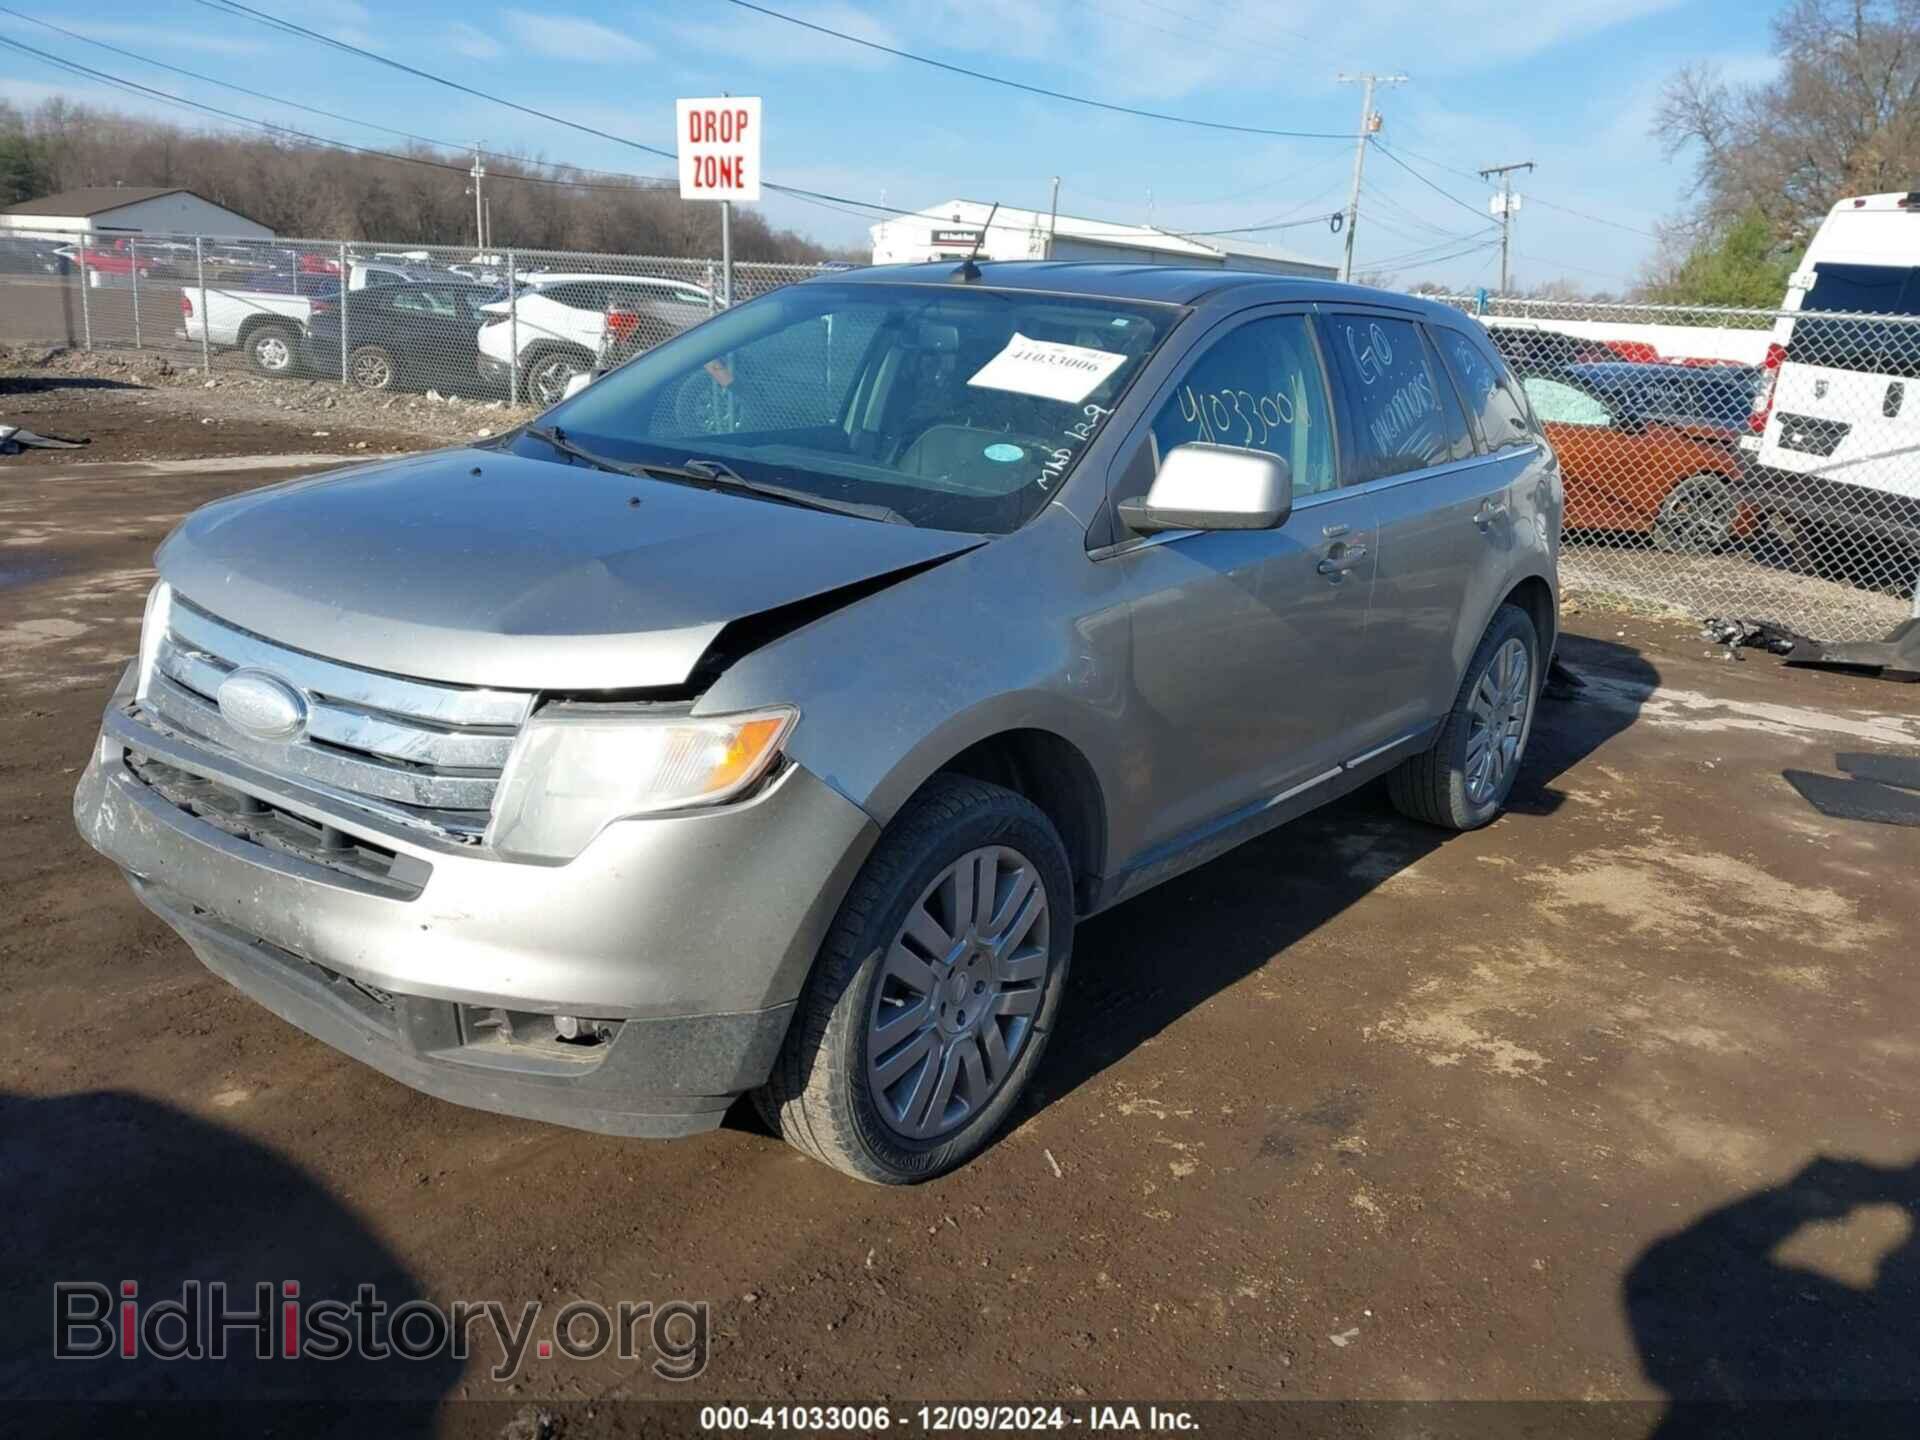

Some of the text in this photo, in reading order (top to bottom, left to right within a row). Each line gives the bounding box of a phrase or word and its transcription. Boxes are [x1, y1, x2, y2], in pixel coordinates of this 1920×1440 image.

[689, 110, 748, 143] DROP
[693, 155, 744, 188] ZONE
[1346, 323, 1393, 385] GO
